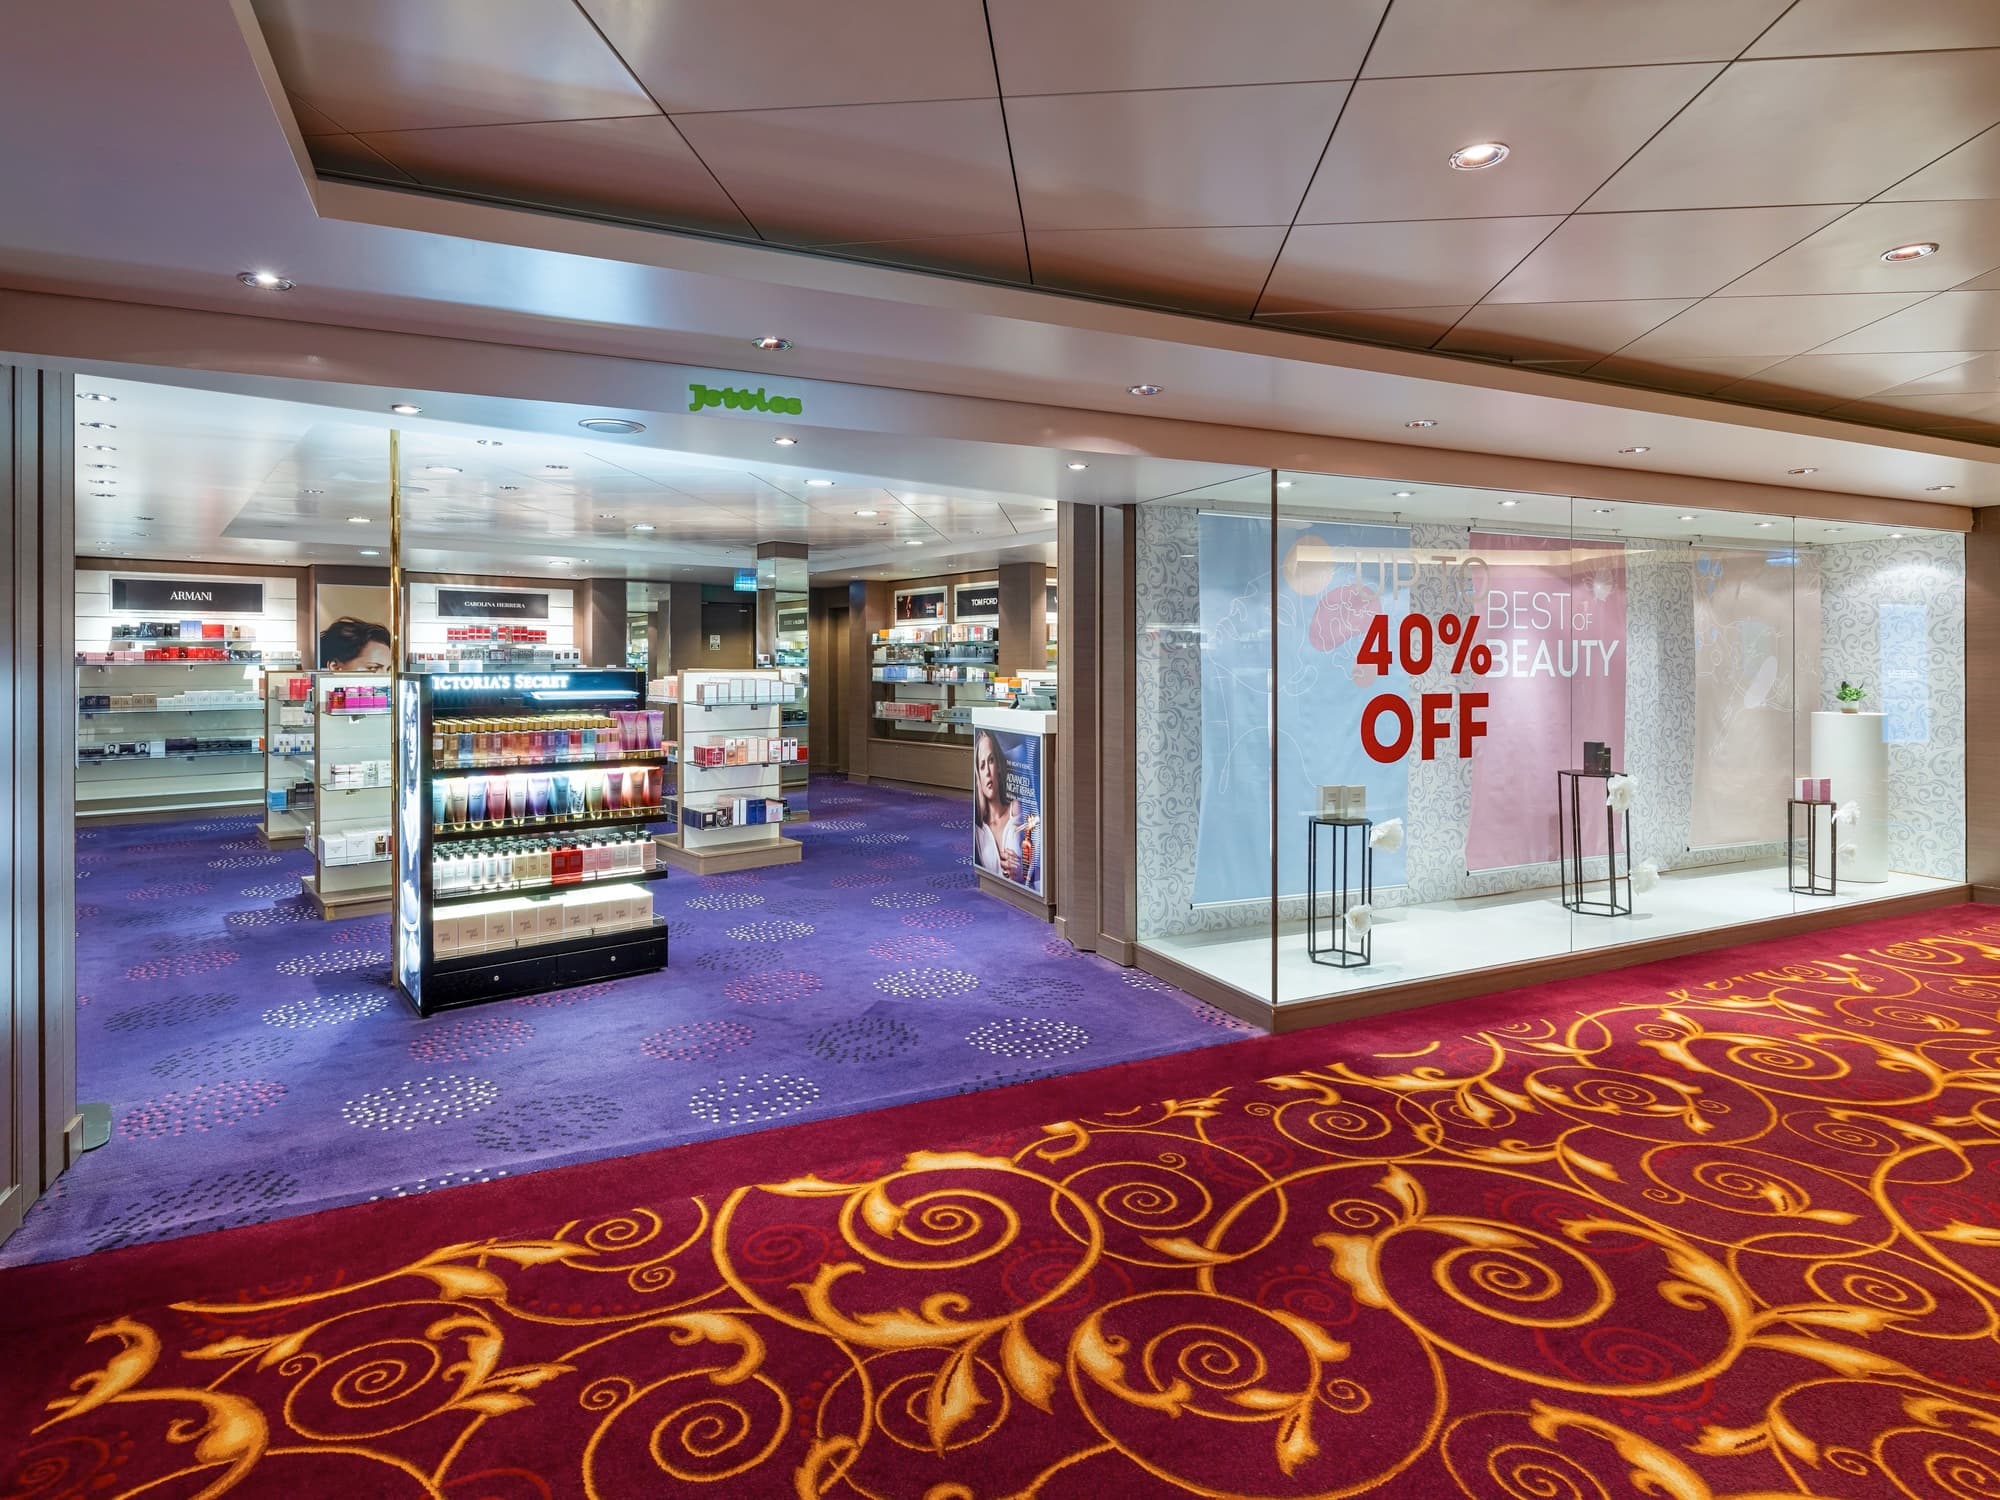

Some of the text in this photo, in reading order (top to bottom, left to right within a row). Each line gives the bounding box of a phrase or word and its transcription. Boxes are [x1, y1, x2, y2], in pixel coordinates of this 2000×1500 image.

[169, 590, 213, 601] ARMANI
[1355, 551, 1490, 603] UP TO
[983, 597, 998, 606] FORD
[1487, 590, 1593, 631] BEST OF
[1356, 613, 1492, 675] 40%
[1485, 639, 1620, 678] BEAUTY
[432, 673, 569, 690] ICTORIA'S SECRET
[1360, 693, 1489, 763] OFF
